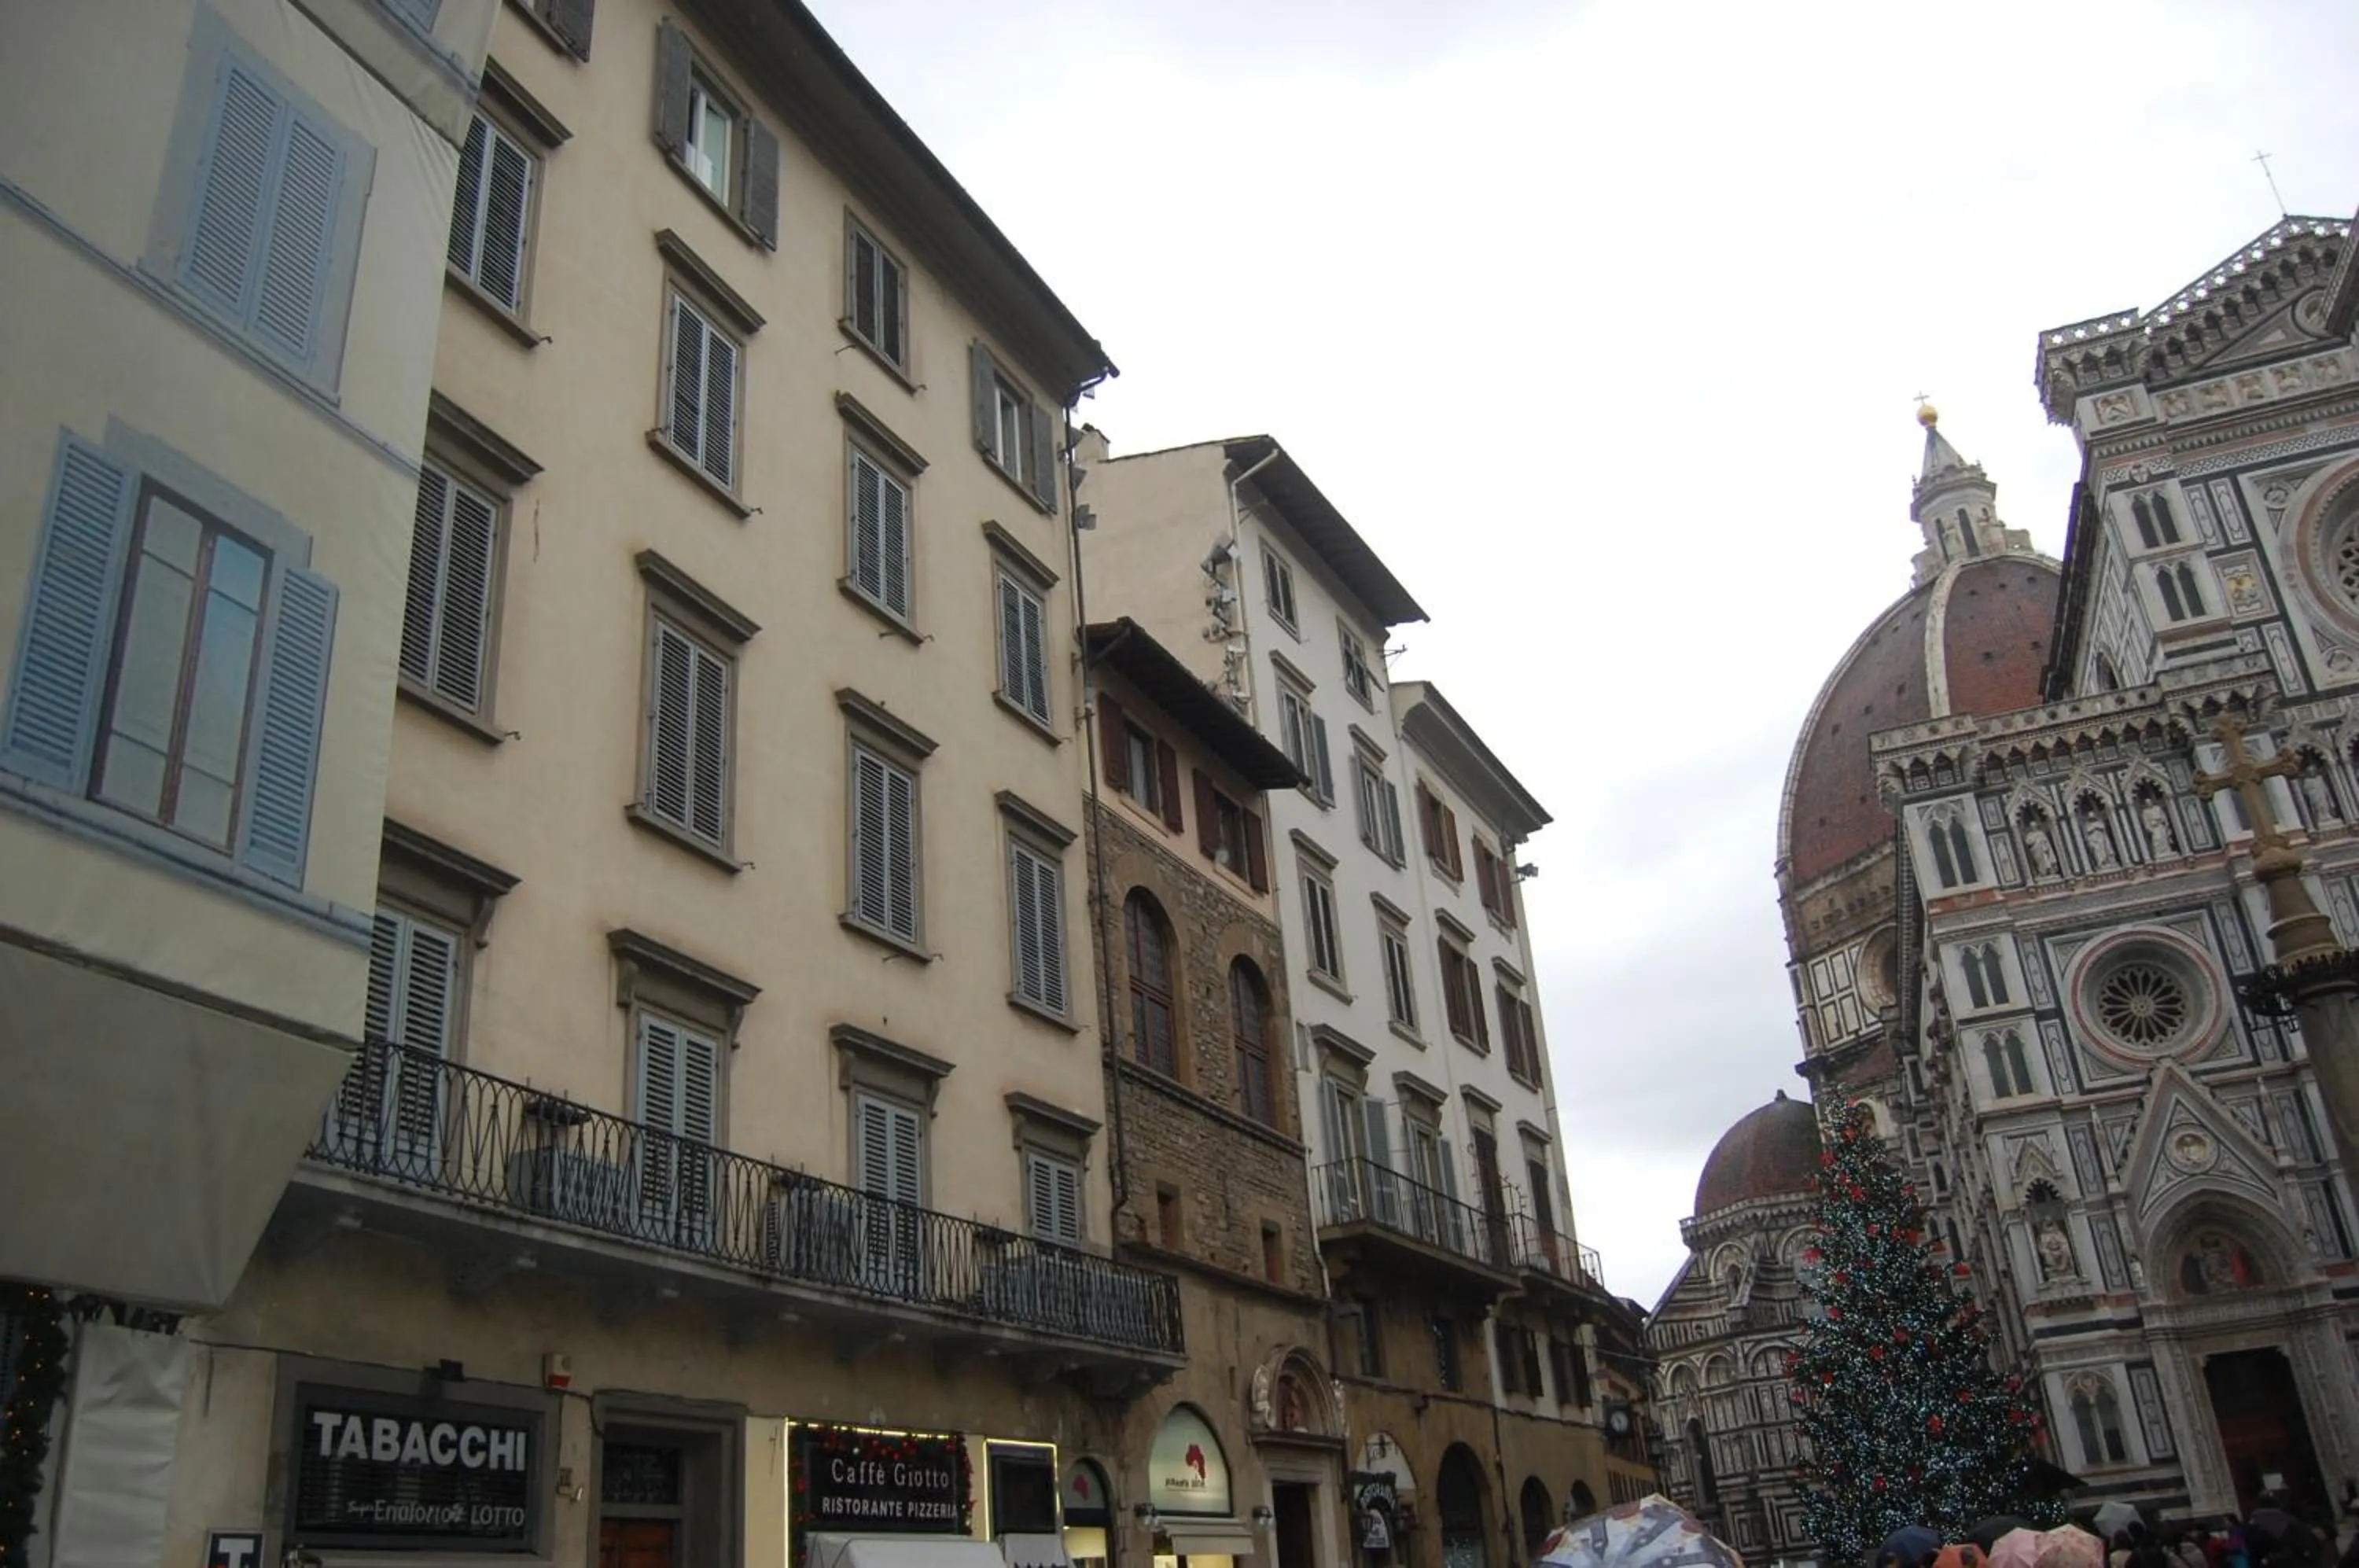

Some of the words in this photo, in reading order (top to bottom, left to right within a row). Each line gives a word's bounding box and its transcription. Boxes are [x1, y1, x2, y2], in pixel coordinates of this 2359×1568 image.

[313, 1412, 527, 1471] TABACCHI
[831, 1458, 885, 1485] Caffè
[894, 1462, 950, 1489] Giotto
[471, 1504, 525, 1526] LOTTO
[822, 1496, 903, 1518] RISTORANTE
[907, 1501, 959, 1519] PIZZERIA
